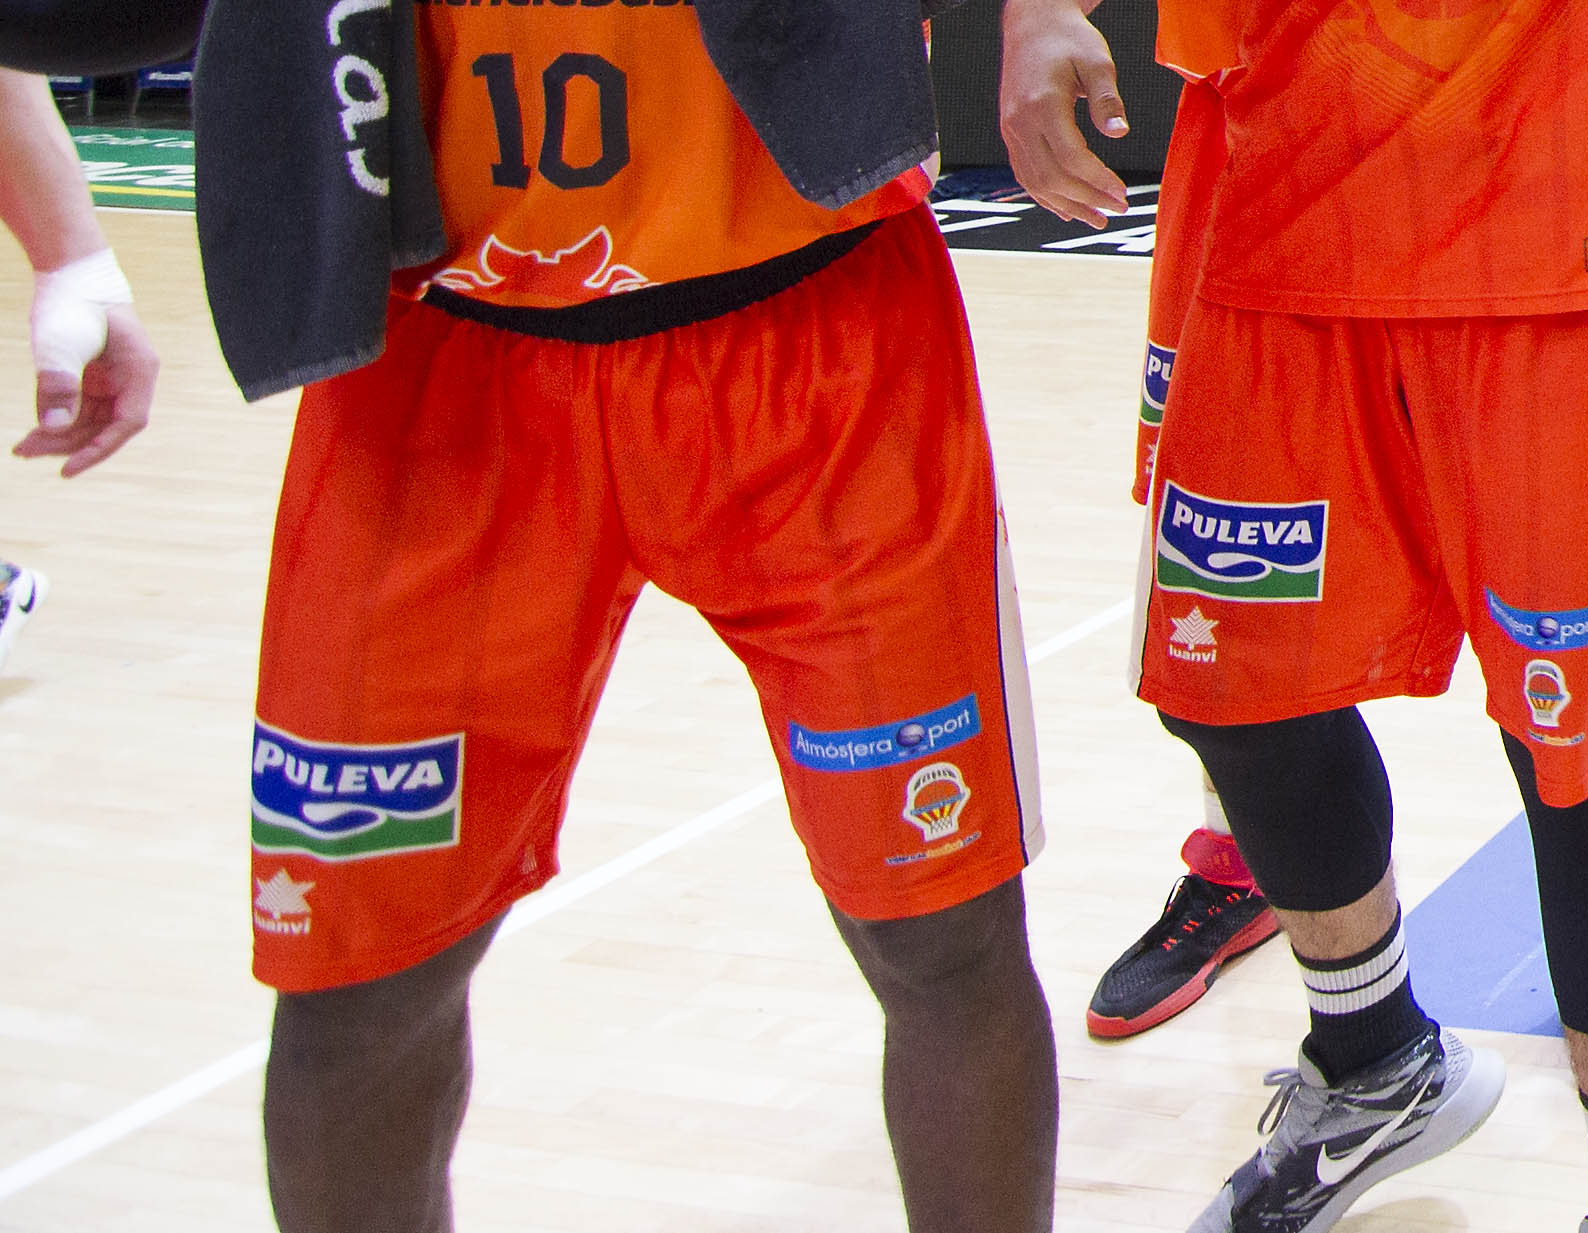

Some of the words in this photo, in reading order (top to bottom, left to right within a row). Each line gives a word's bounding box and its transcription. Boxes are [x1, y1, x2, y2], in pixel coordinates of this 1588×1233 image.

[472, 52, 631, 190] 10
[1172, 499, 1314, 546] PULEVA
[253, 737, 445, 794] PULEVA
